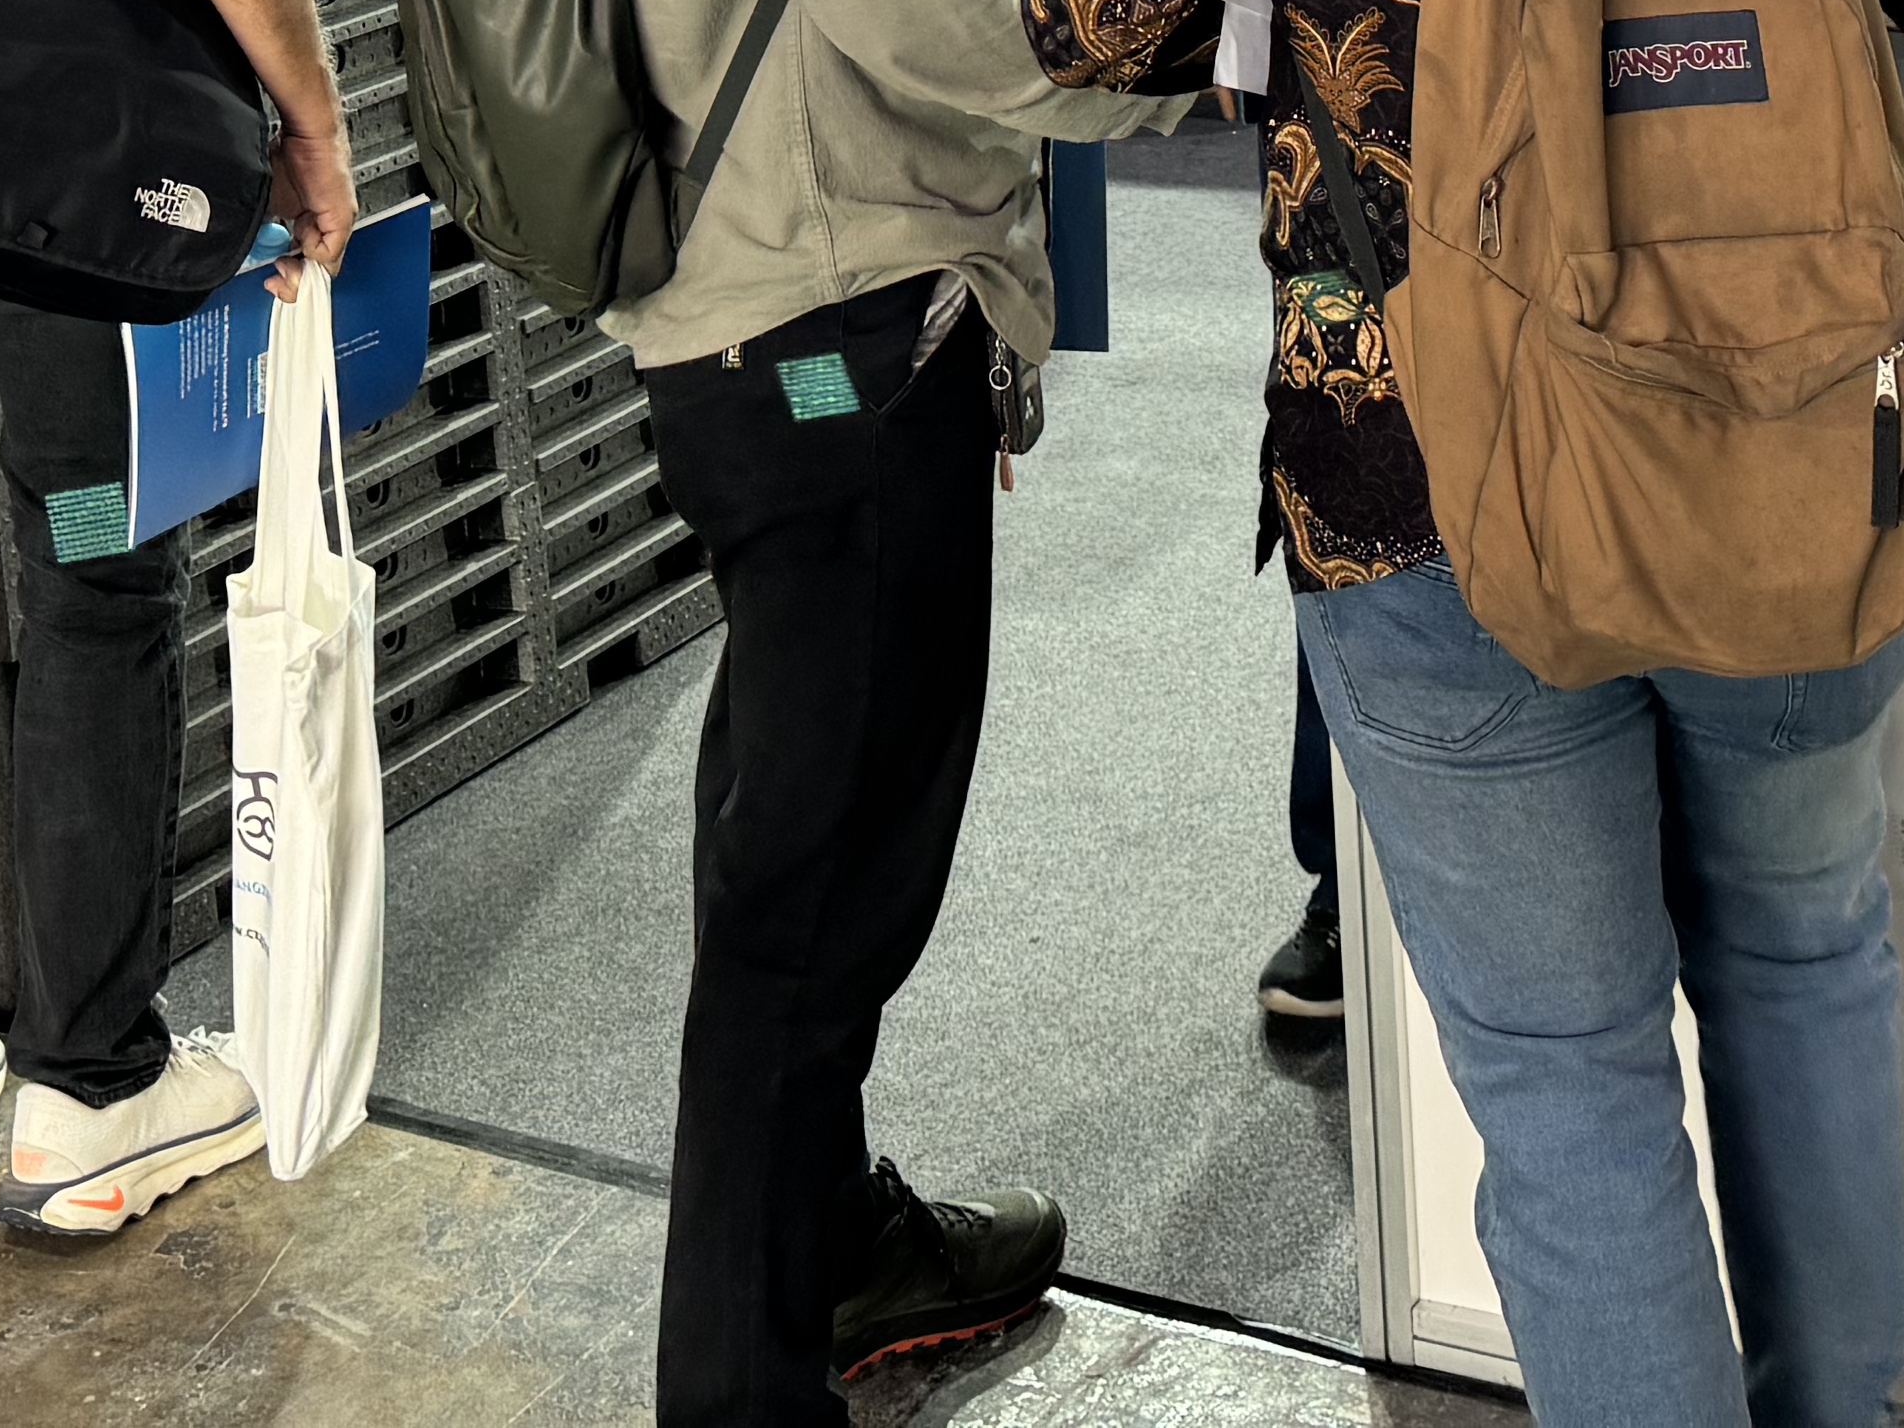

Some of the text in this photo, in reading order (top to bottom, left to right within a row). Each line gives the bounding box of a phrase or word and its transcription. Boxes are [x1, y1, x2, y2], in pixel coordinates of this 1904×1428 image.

[1608, 40, 1747, 87] JANSPORT
[161, 178, 191, 195] THE
[134, 187, 187, 212] NORTH
[141, 203, 182, 223] FACE
